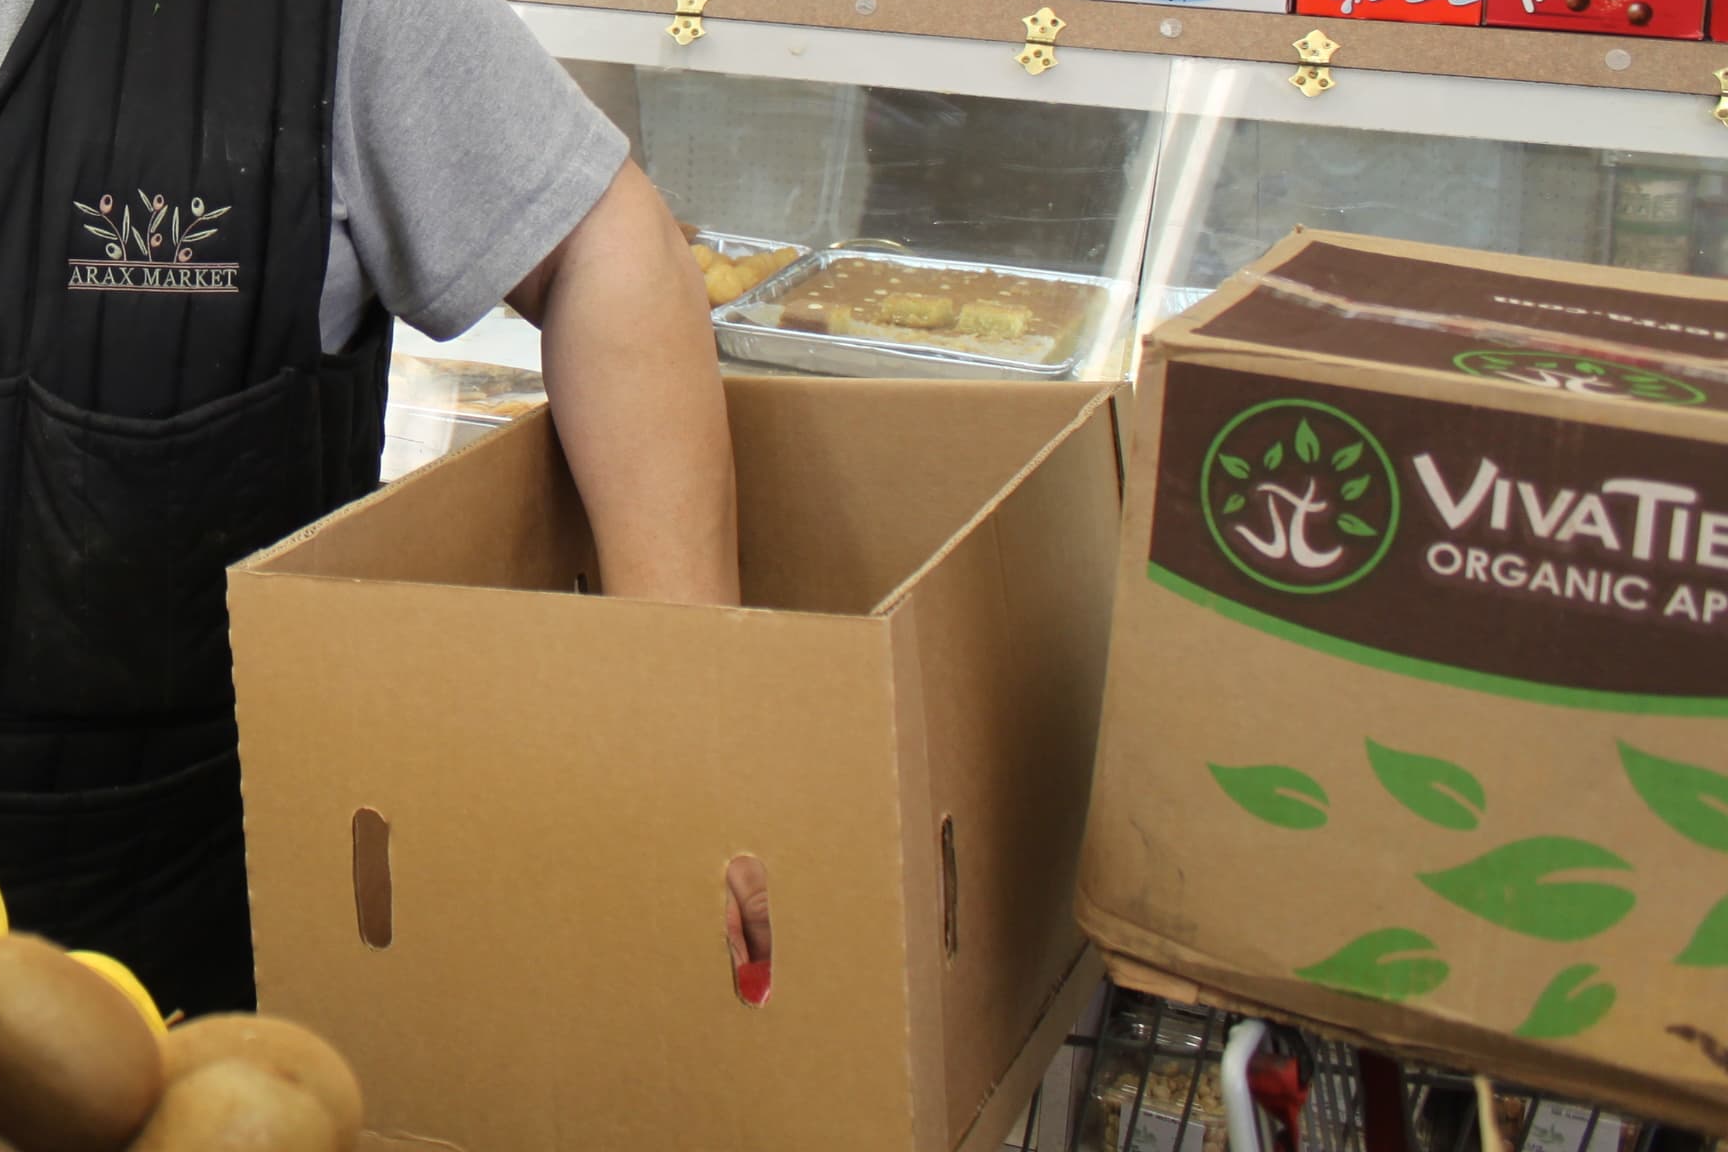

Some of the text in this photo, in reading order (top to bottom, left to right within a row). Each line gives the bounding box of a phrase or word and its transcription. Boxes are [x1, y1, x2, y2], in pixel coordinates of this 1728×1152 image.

[69, 266, 238, 288] ARAX MARKET
[1427, 542, 1650, 610] ORGANIC
